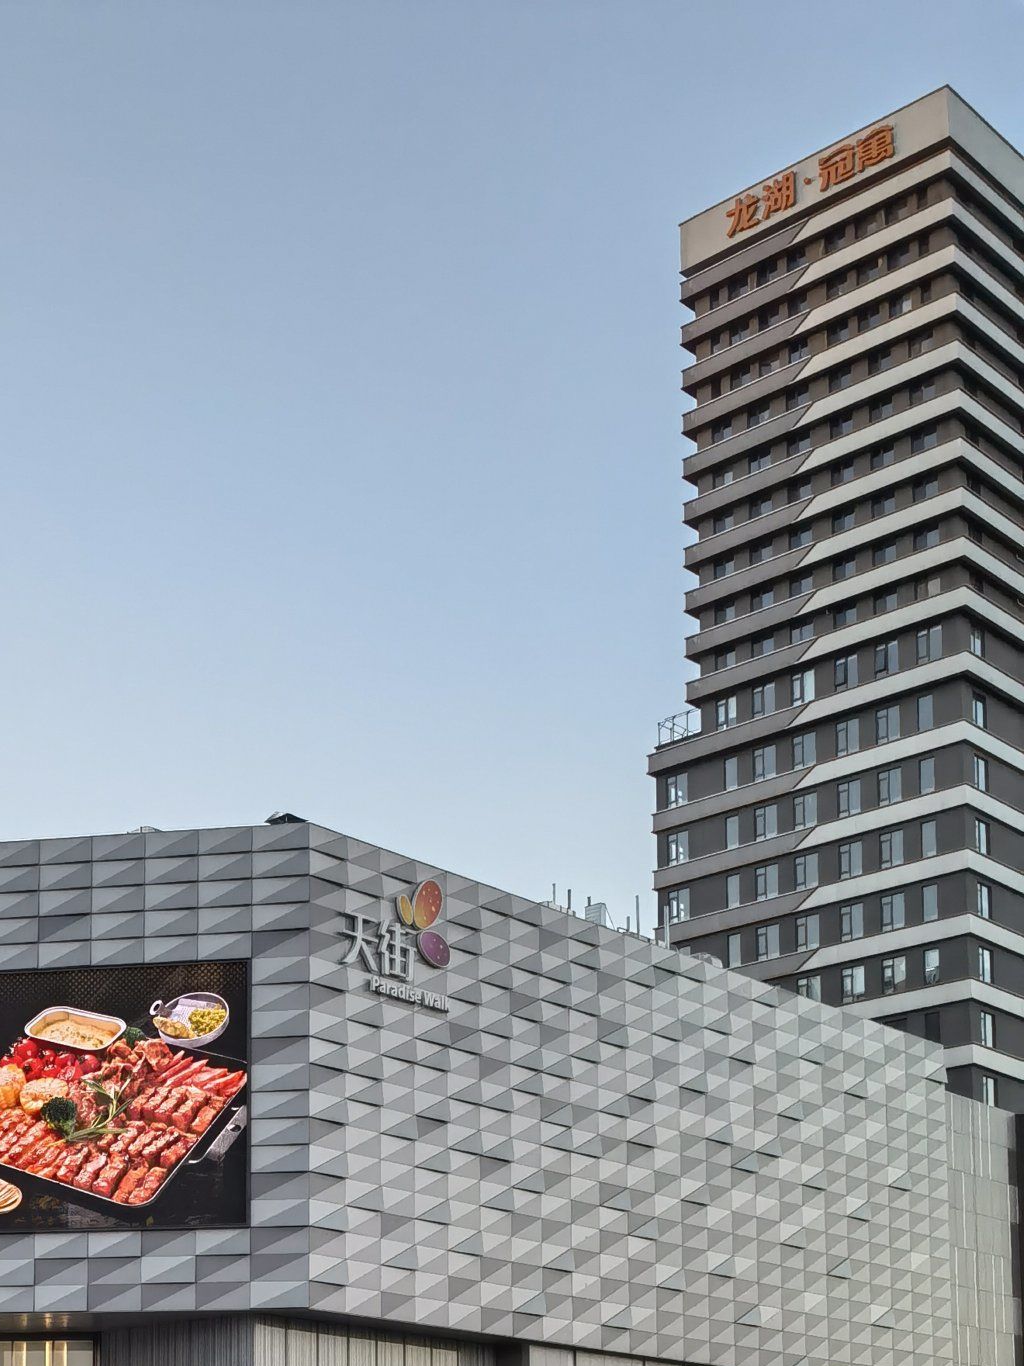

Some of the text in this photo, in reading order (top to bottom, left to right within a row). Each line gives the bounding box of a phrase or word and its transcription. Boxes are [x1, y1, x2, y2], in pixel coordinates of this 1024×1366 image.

[340, 911, 420, 982] 天街
[370, 976, 450, 1012] Paradise Walk
